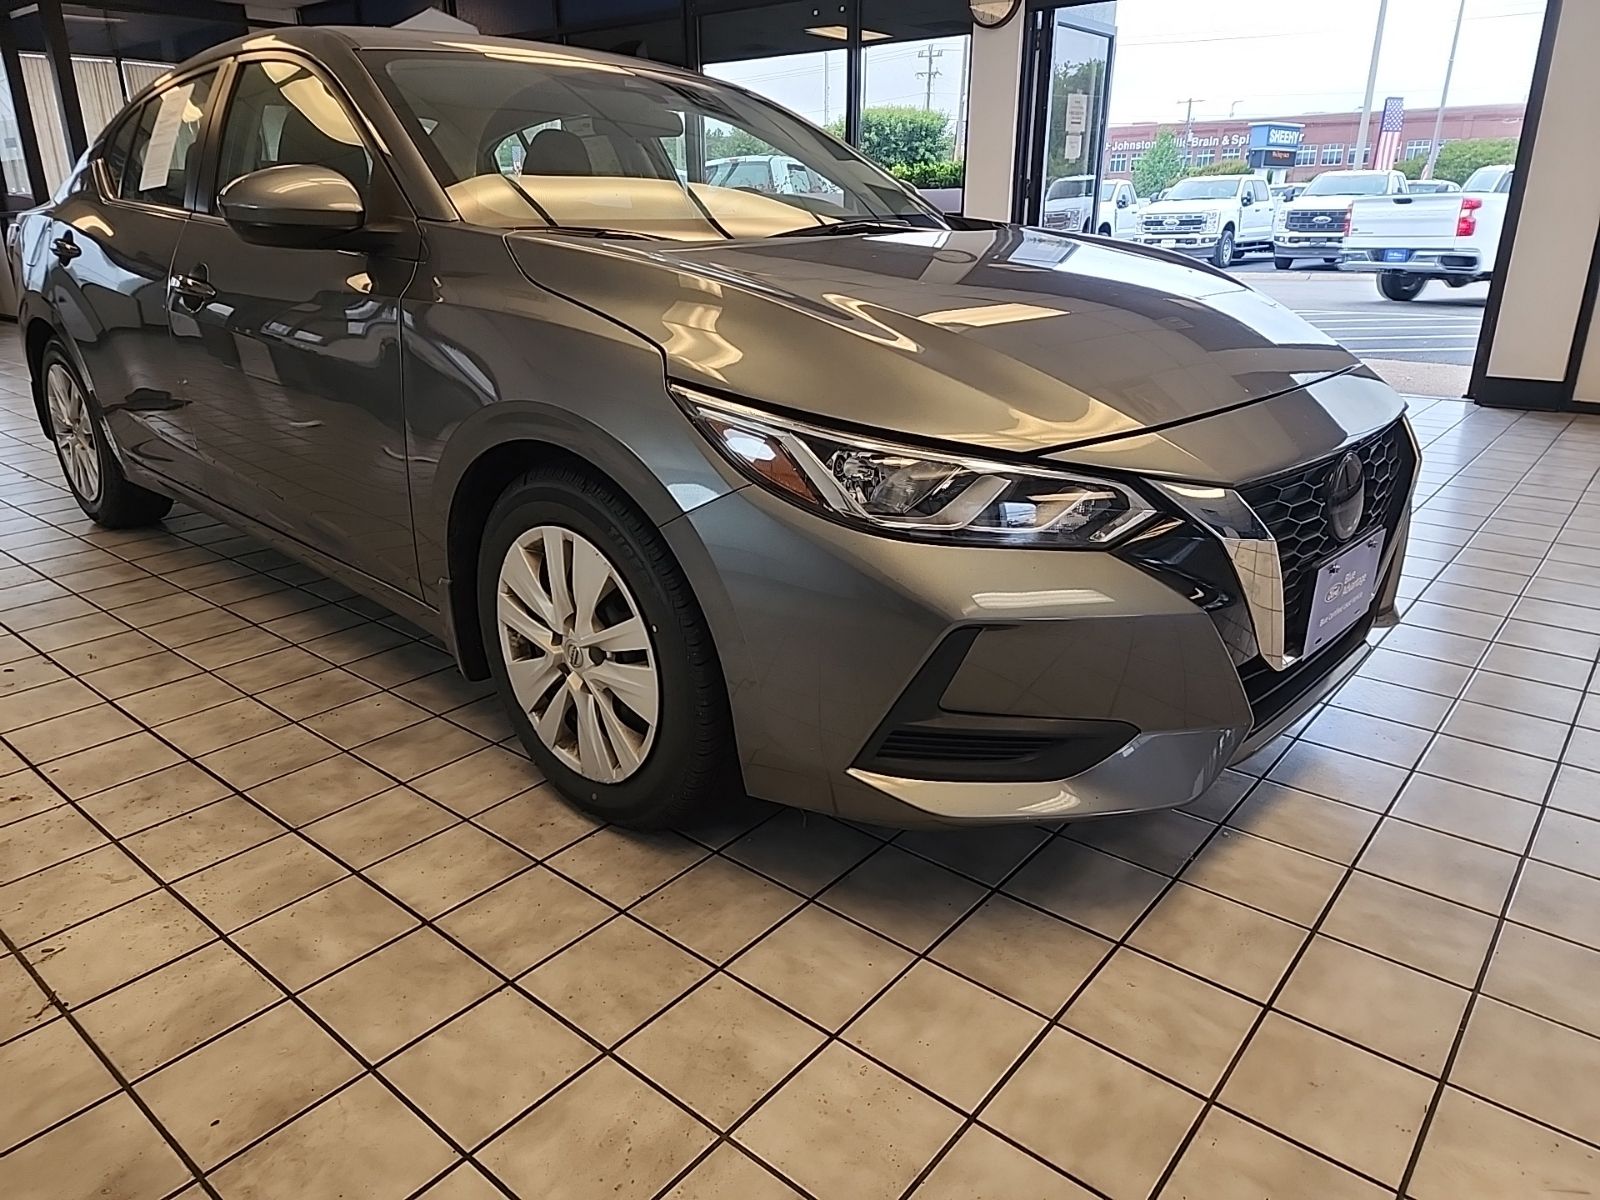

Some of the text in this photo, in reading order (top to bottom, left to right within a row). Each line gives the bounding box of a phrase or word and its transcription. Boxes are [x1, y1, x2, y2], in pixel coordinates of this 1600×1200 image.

[1111, 140, 1157, 151] Johnston
[1191, 135, 1219, 147] Brain
[1221, 135, 1230, 145] &
[1231, 133, 1250, 147] Spi
[1269, 129, 1299, 144] SHEEHY
